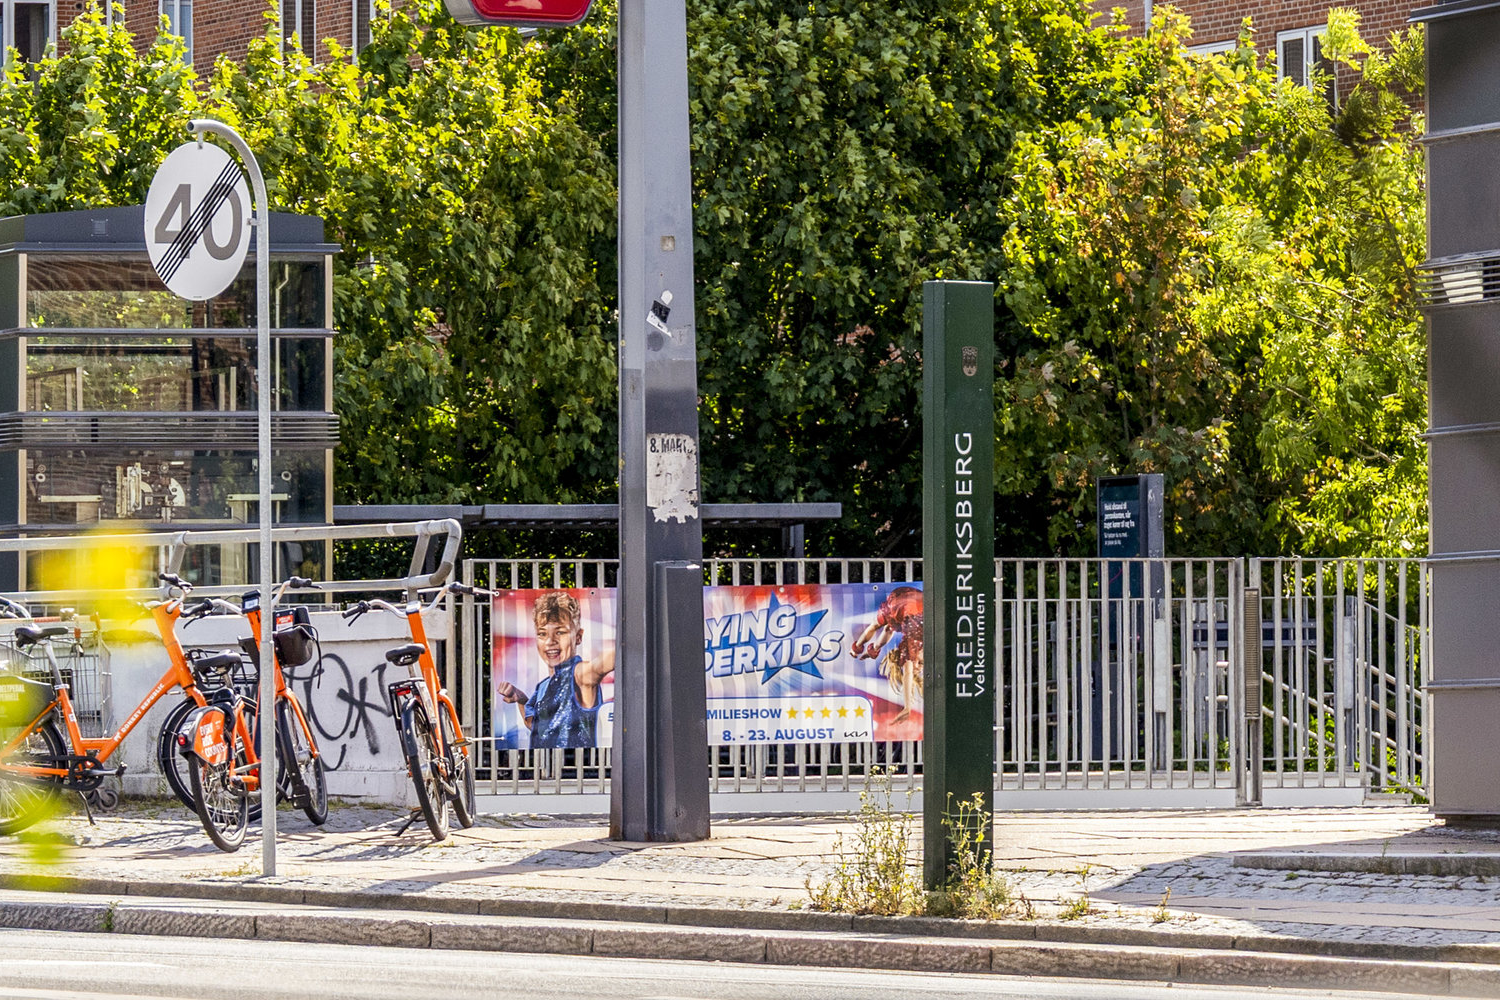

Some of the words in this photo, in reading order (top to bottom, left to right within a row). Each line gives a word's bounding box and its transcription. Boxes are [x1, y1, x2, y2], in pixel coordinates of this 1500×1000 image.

[155, 183, 243, 261] 40
[954, 432, 973, 698] FREDERIKSBERG
[974, 592, 986, 698] Velkommen
[121, 709, 141, 733] DONKEY
[140, 682, 165, 711] REPUBLIC
[706, 708, 783, 721] MILIESHOW
[722, 730, 736, 742] 8.
[749, 729, 771, 742] 23.
[774, 728, 835, 741] AUGUST
